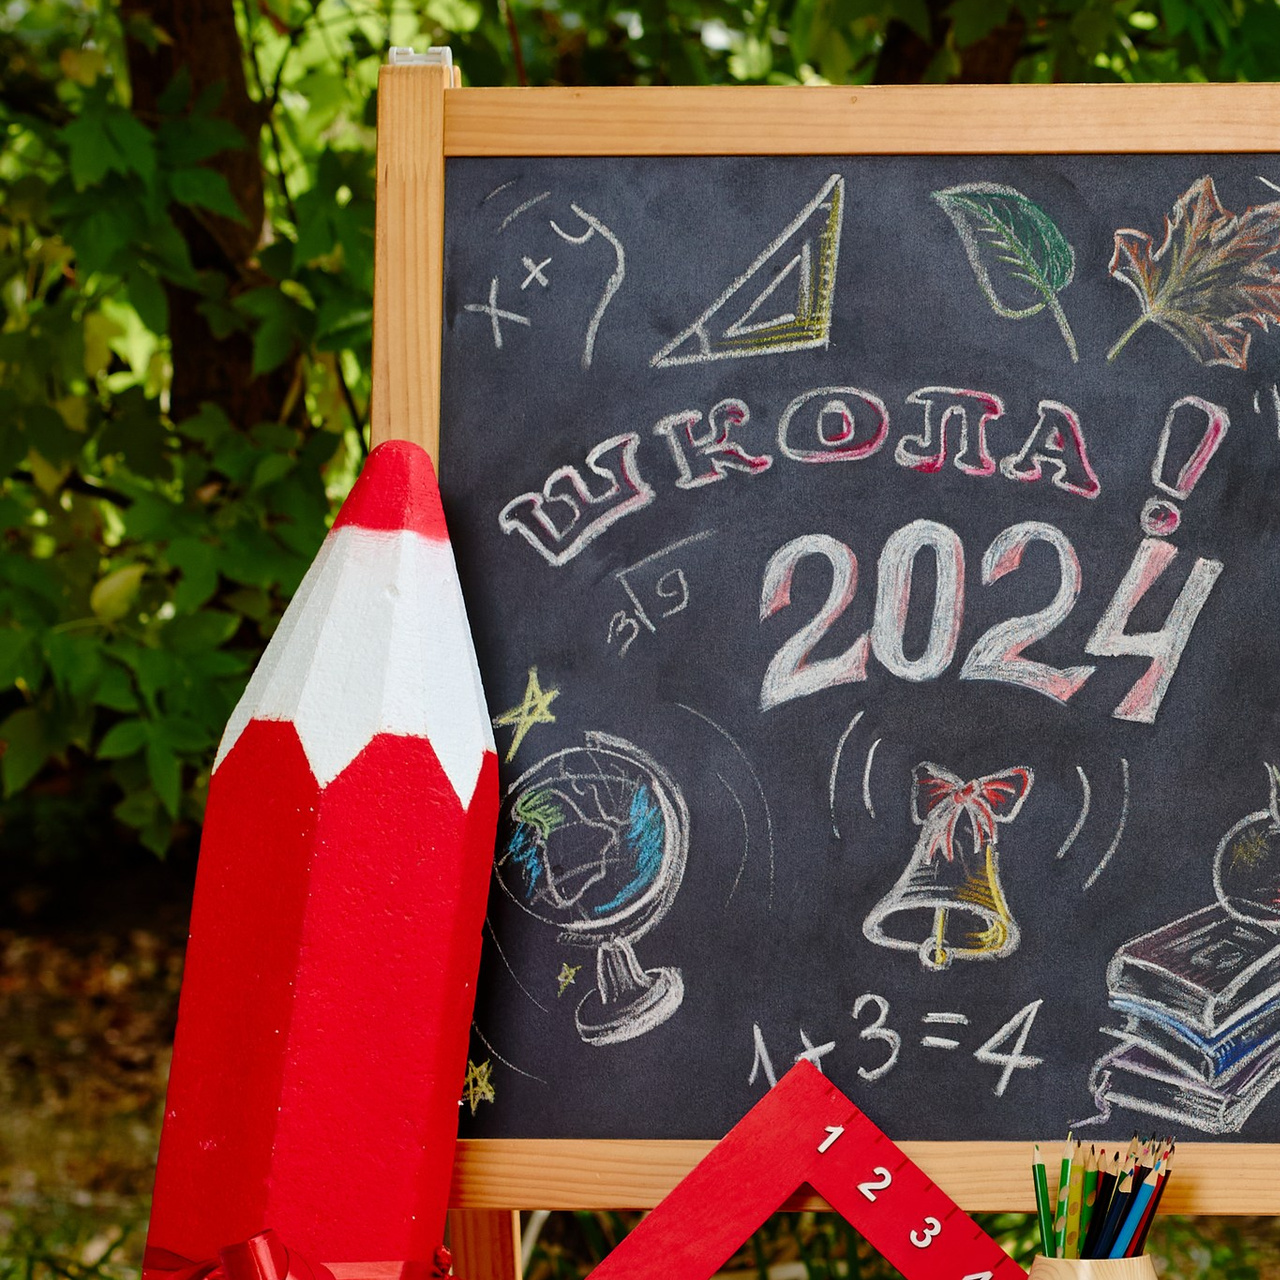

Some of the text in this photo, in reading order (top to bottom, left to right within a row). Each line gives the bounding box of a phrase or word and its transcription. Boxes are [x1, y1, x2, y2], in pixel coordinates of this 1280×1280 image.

[499, 385, 1231, 567] ШКОЛА!
[759, 519, 1225, 725] 2024
[816, 1124, 846, 1154] 1
[856, 1166, 893, 1203] 2
[909, 1216, 942, 1249] 3
